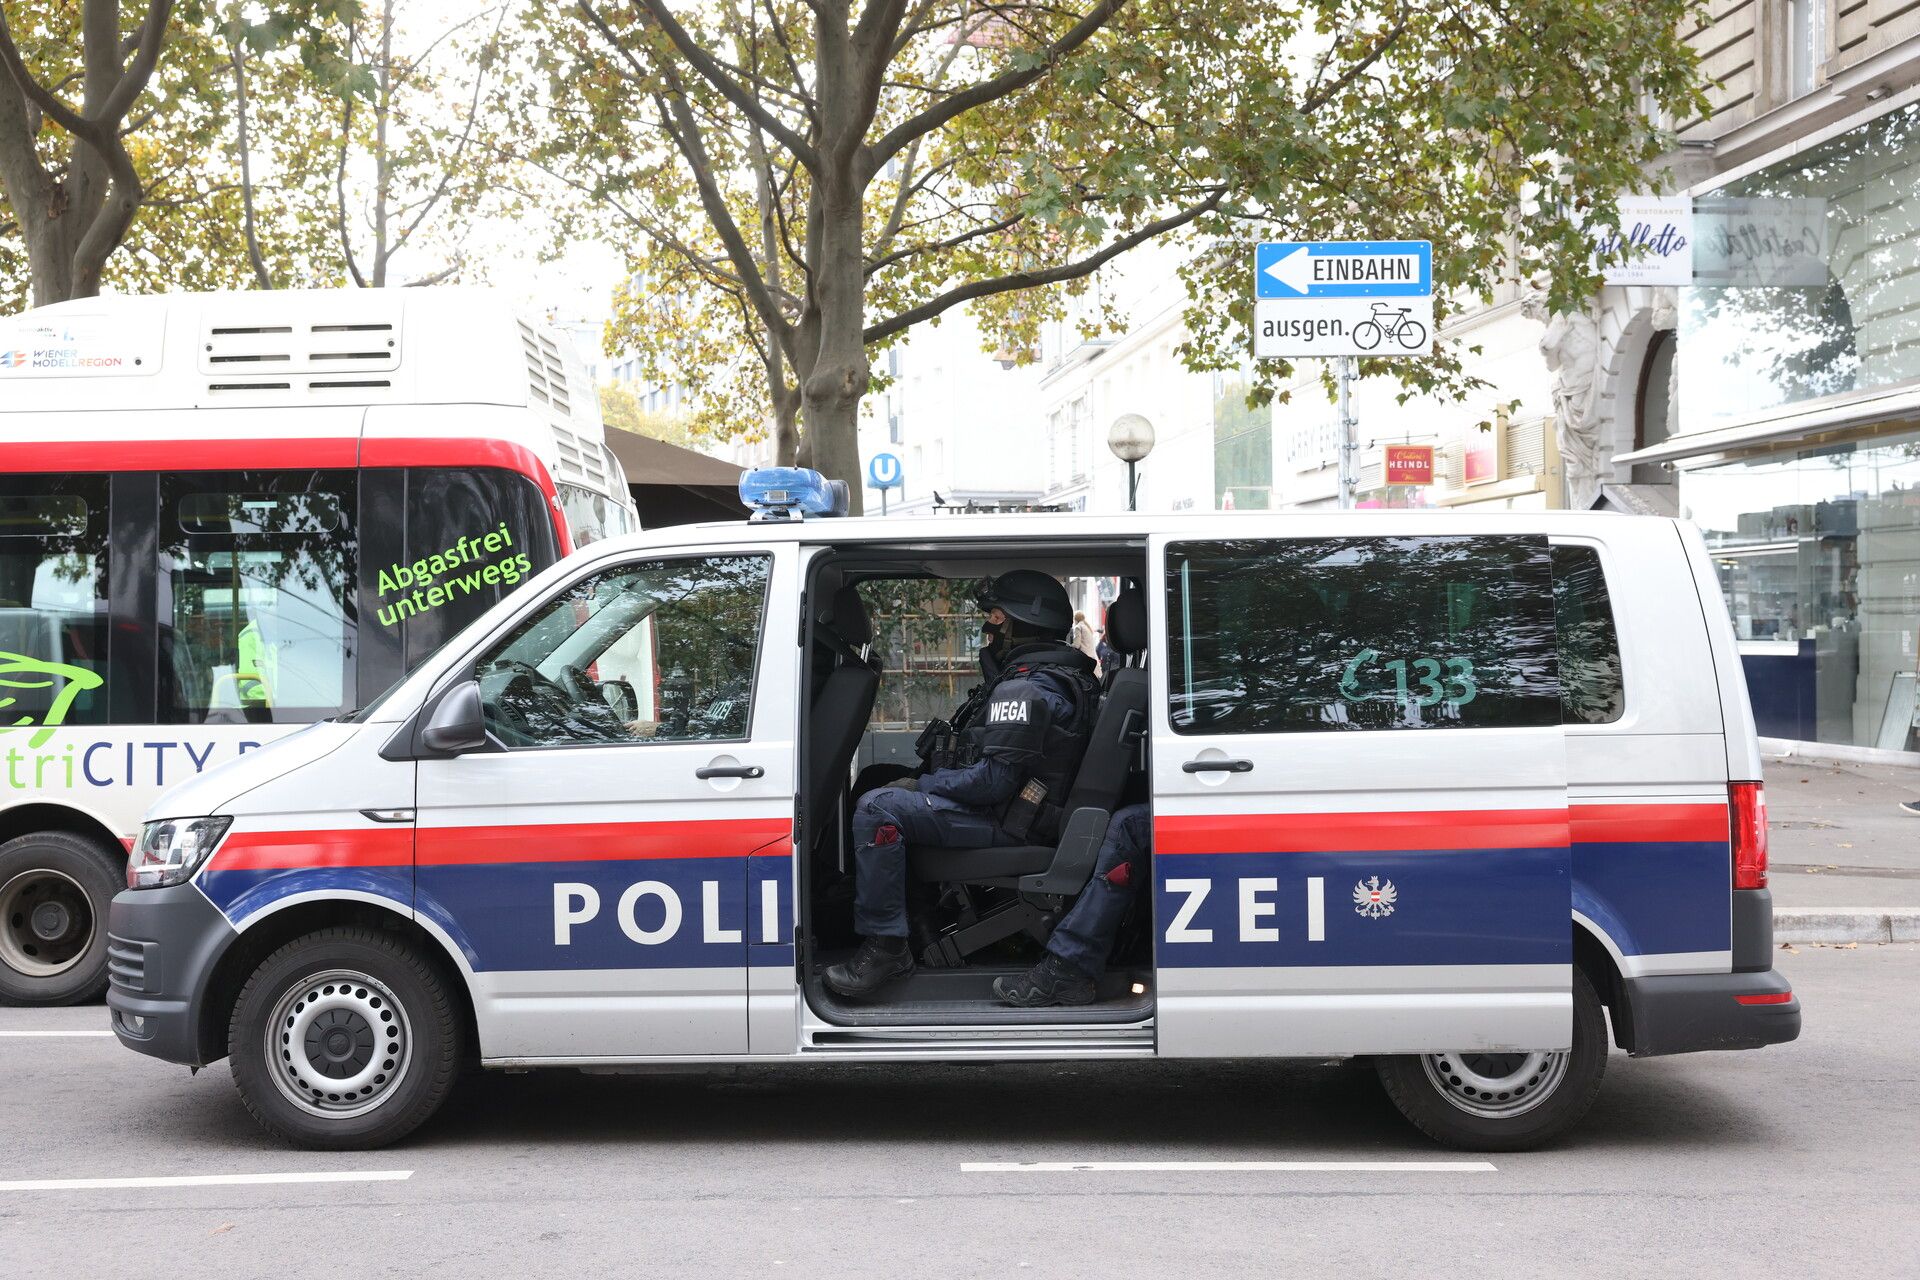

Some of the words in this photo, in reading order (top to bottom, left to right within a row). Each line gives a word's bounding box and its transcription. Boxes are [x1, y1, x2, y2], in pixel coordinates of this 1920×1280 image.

[1313, 258, 1410, 281] EINBAHN
[1263, 318, 1350, 342] ausgen.
[32, 358, 122, 368] MODELLREGION
[874, 458, 896, 482] U
[1389, 460, 1430, 469] HEINDL
[378, 522, 513, 597] Abgasfrei
[377, 553, 532, 626] unterwegs
[1385, 657, 1476, 706] 133
[990, 700, 1028, 722] WEGA
[553, 880, 779, 945] POLI
[1165, 876, 1325, 943] ZEI
